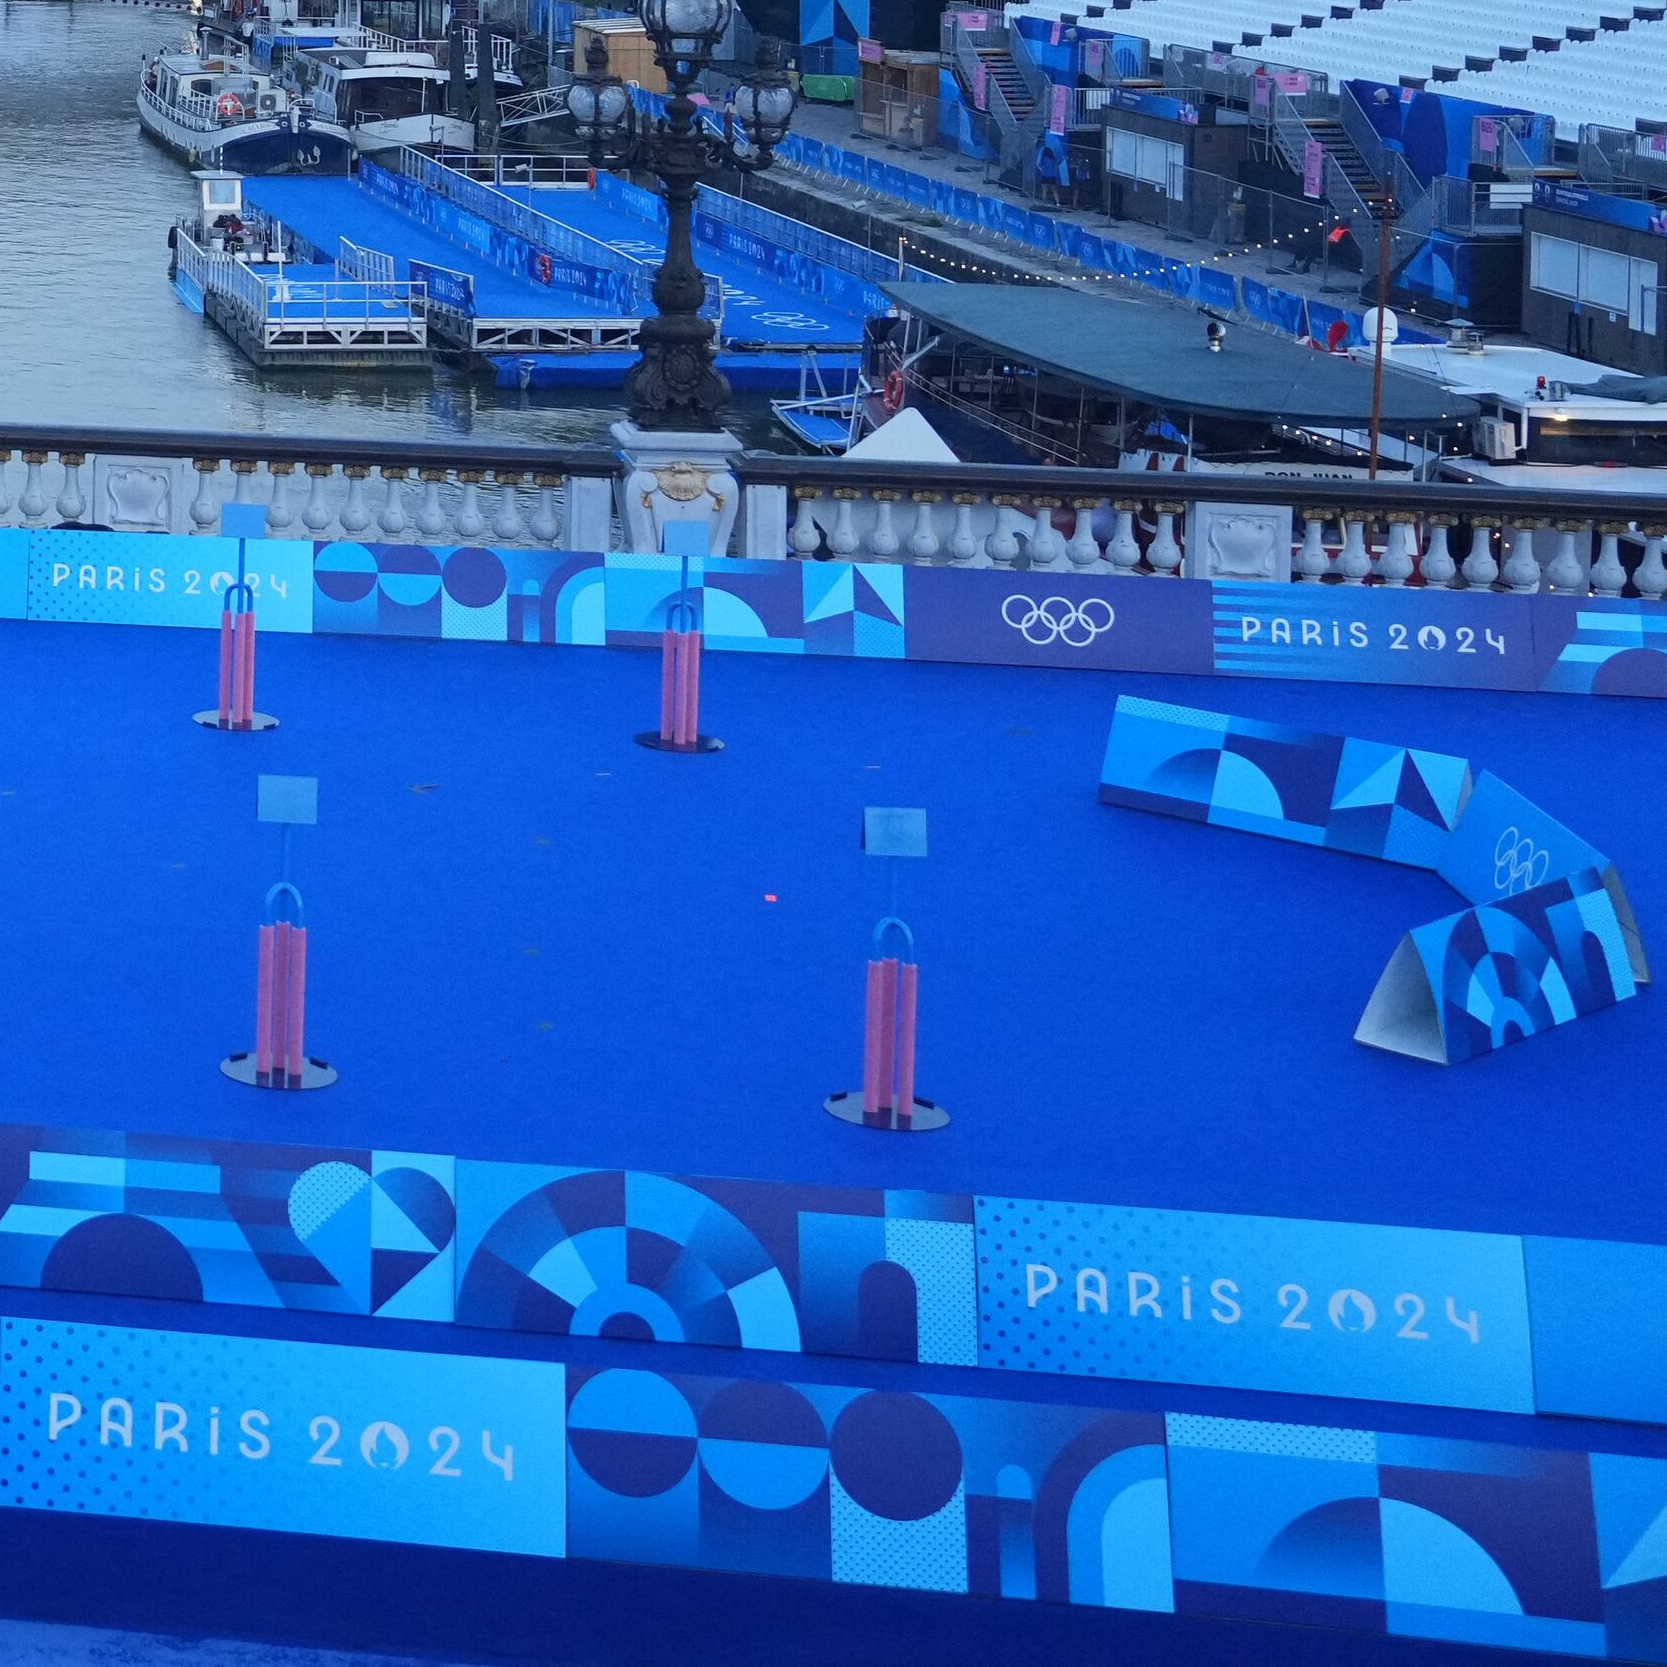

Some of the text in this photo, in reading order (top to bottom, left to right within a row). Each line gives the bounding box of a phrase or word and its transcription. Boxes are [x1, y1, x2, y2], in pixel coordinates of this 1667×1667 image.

[183, 569, 288, 599] 2024
[1388, 623, 1506, 655] 2024
[1277, 1283, 1480, 1344] 2024
[309, 1415, 514, 1482] 2024
